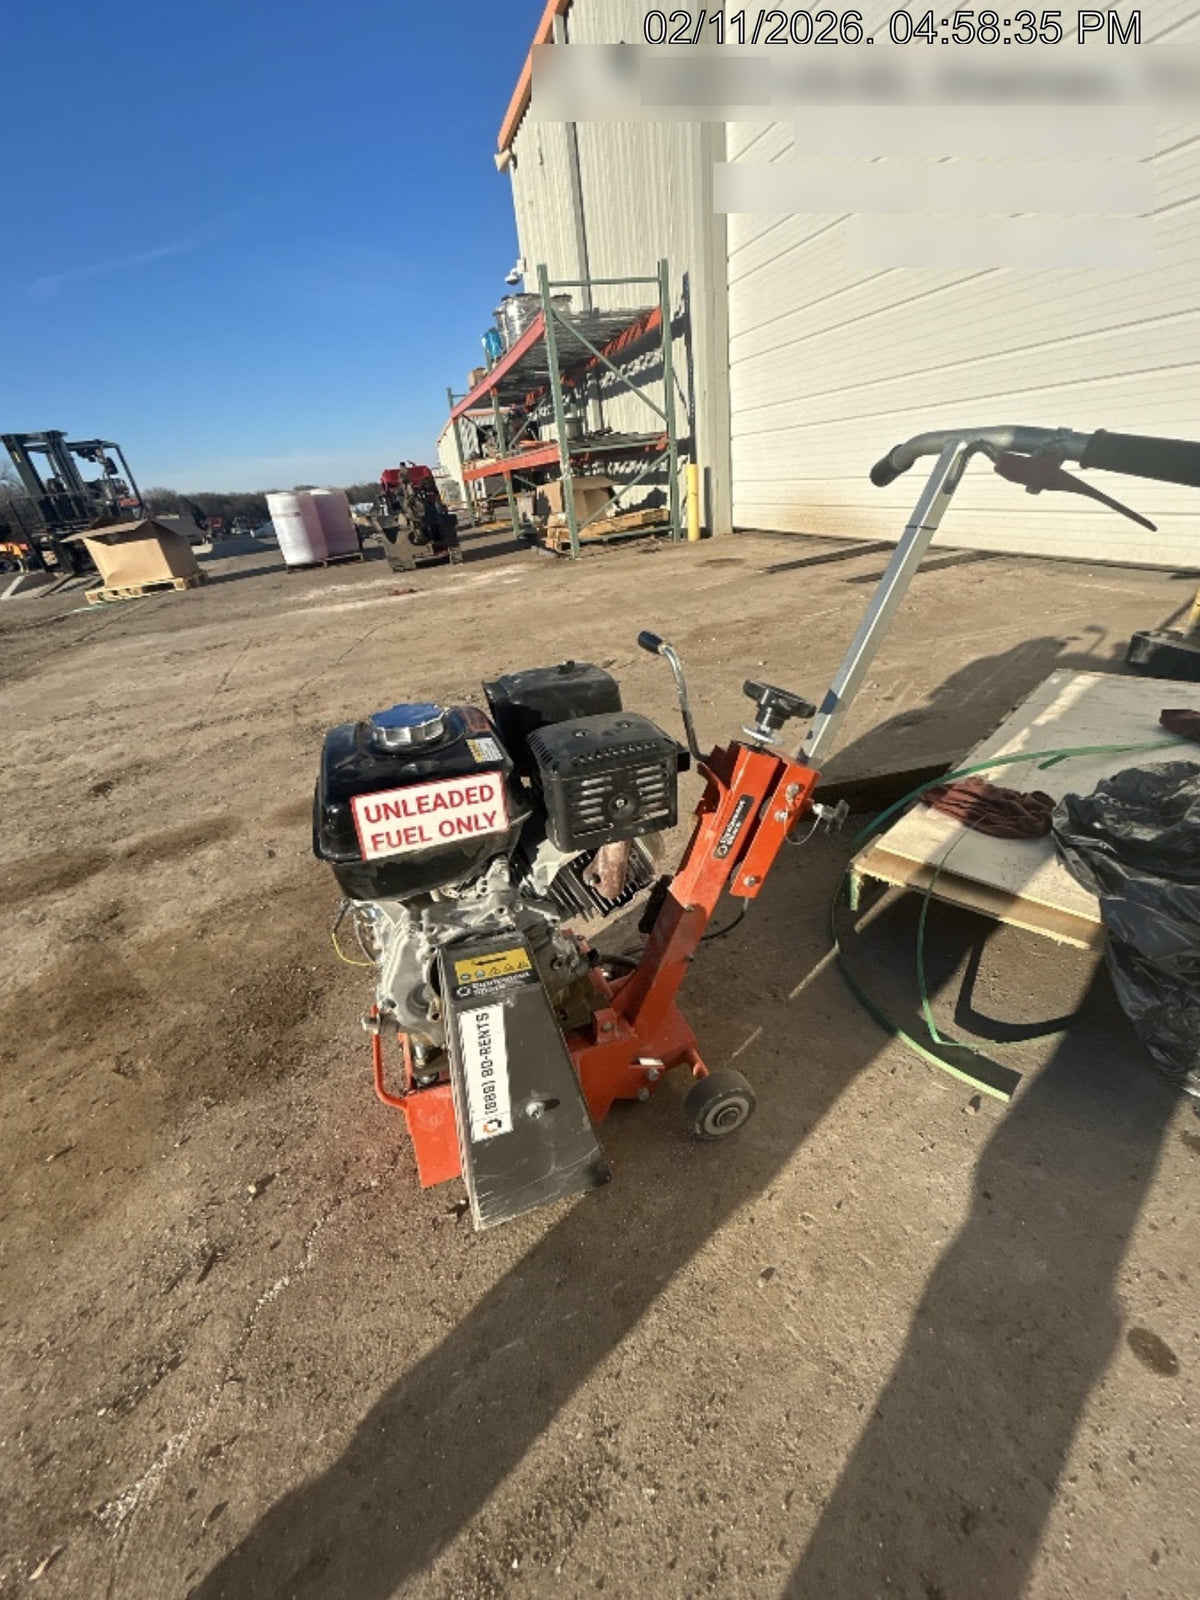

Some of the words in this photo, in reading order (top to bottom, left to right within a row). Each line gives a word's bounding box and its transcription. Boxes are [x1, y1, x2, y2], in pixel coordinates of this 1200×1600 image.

[364, 784, 494, 824] UNLEADED
[370, 825, 432, 851] FUEL
[438, 810, 497, 837] ONLY
[475, 1012, 494, 1079] 80-RENTS
[482, 1079, 499, 1115] (888)
